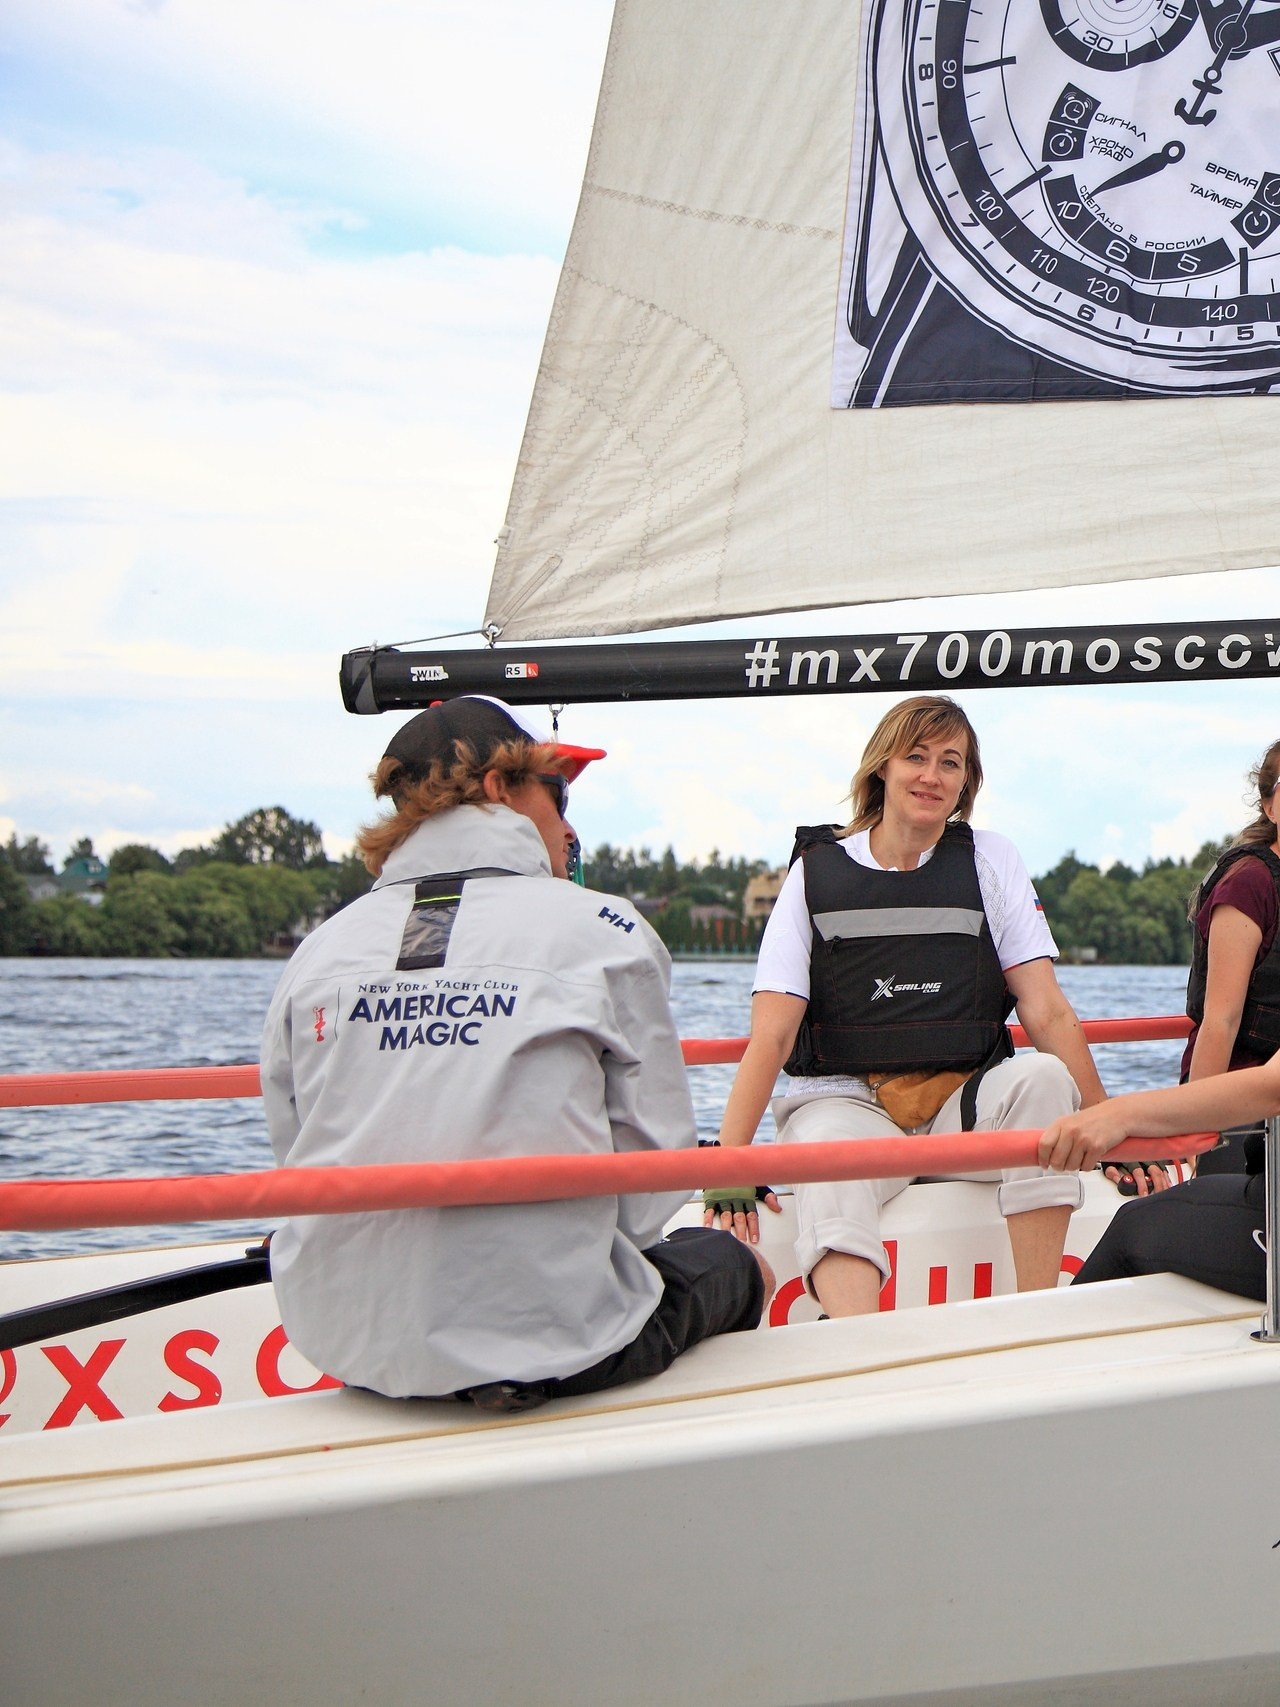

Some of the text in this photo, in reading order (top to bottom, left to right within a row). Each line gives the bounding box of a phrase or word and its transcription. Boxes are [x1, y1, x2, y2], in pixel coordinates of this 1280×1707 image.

[1082, 30, 1114, 52] 30
[918, 63, 934, 81] 8
[941, 59, 957, 89] 90
[1094, 112, 1146, 143] СИГНАЛ
[1088, 136, 1134, 159] ХРОНО
[1090, 145, 1124, 162] ГРАФ
[1205, 162, 1259, 190] ВРЕМЯ
[974, 189, 1003, 221] 100
[1189, 183, 1243, 211] ТАЙМЕР
[961, 213, 980, 228] 7
[1056, 201, 1082, 220] 10
[1079, 185, 1124, 233] СДЕЛАНО
[1144, 236, 1207, 251] РОССИИ
[1029, 248, 1059, 274] 110
[1105, 239, 1131, 263] 6
[1177, 253, 1201, 273] 5
[1086, 277, 1120, 304] 120
[1077, 303, 1096, 321] 6
[1201, 303, 1238, 321] 140
[1237, 326, 1254, 340] 5
[357, 979, 519, 994] NEW YORK YACHT CLUB
[349, 993, 516, 1023] AMERICAN
[379, 1021, 483, 1051] MAGIC
